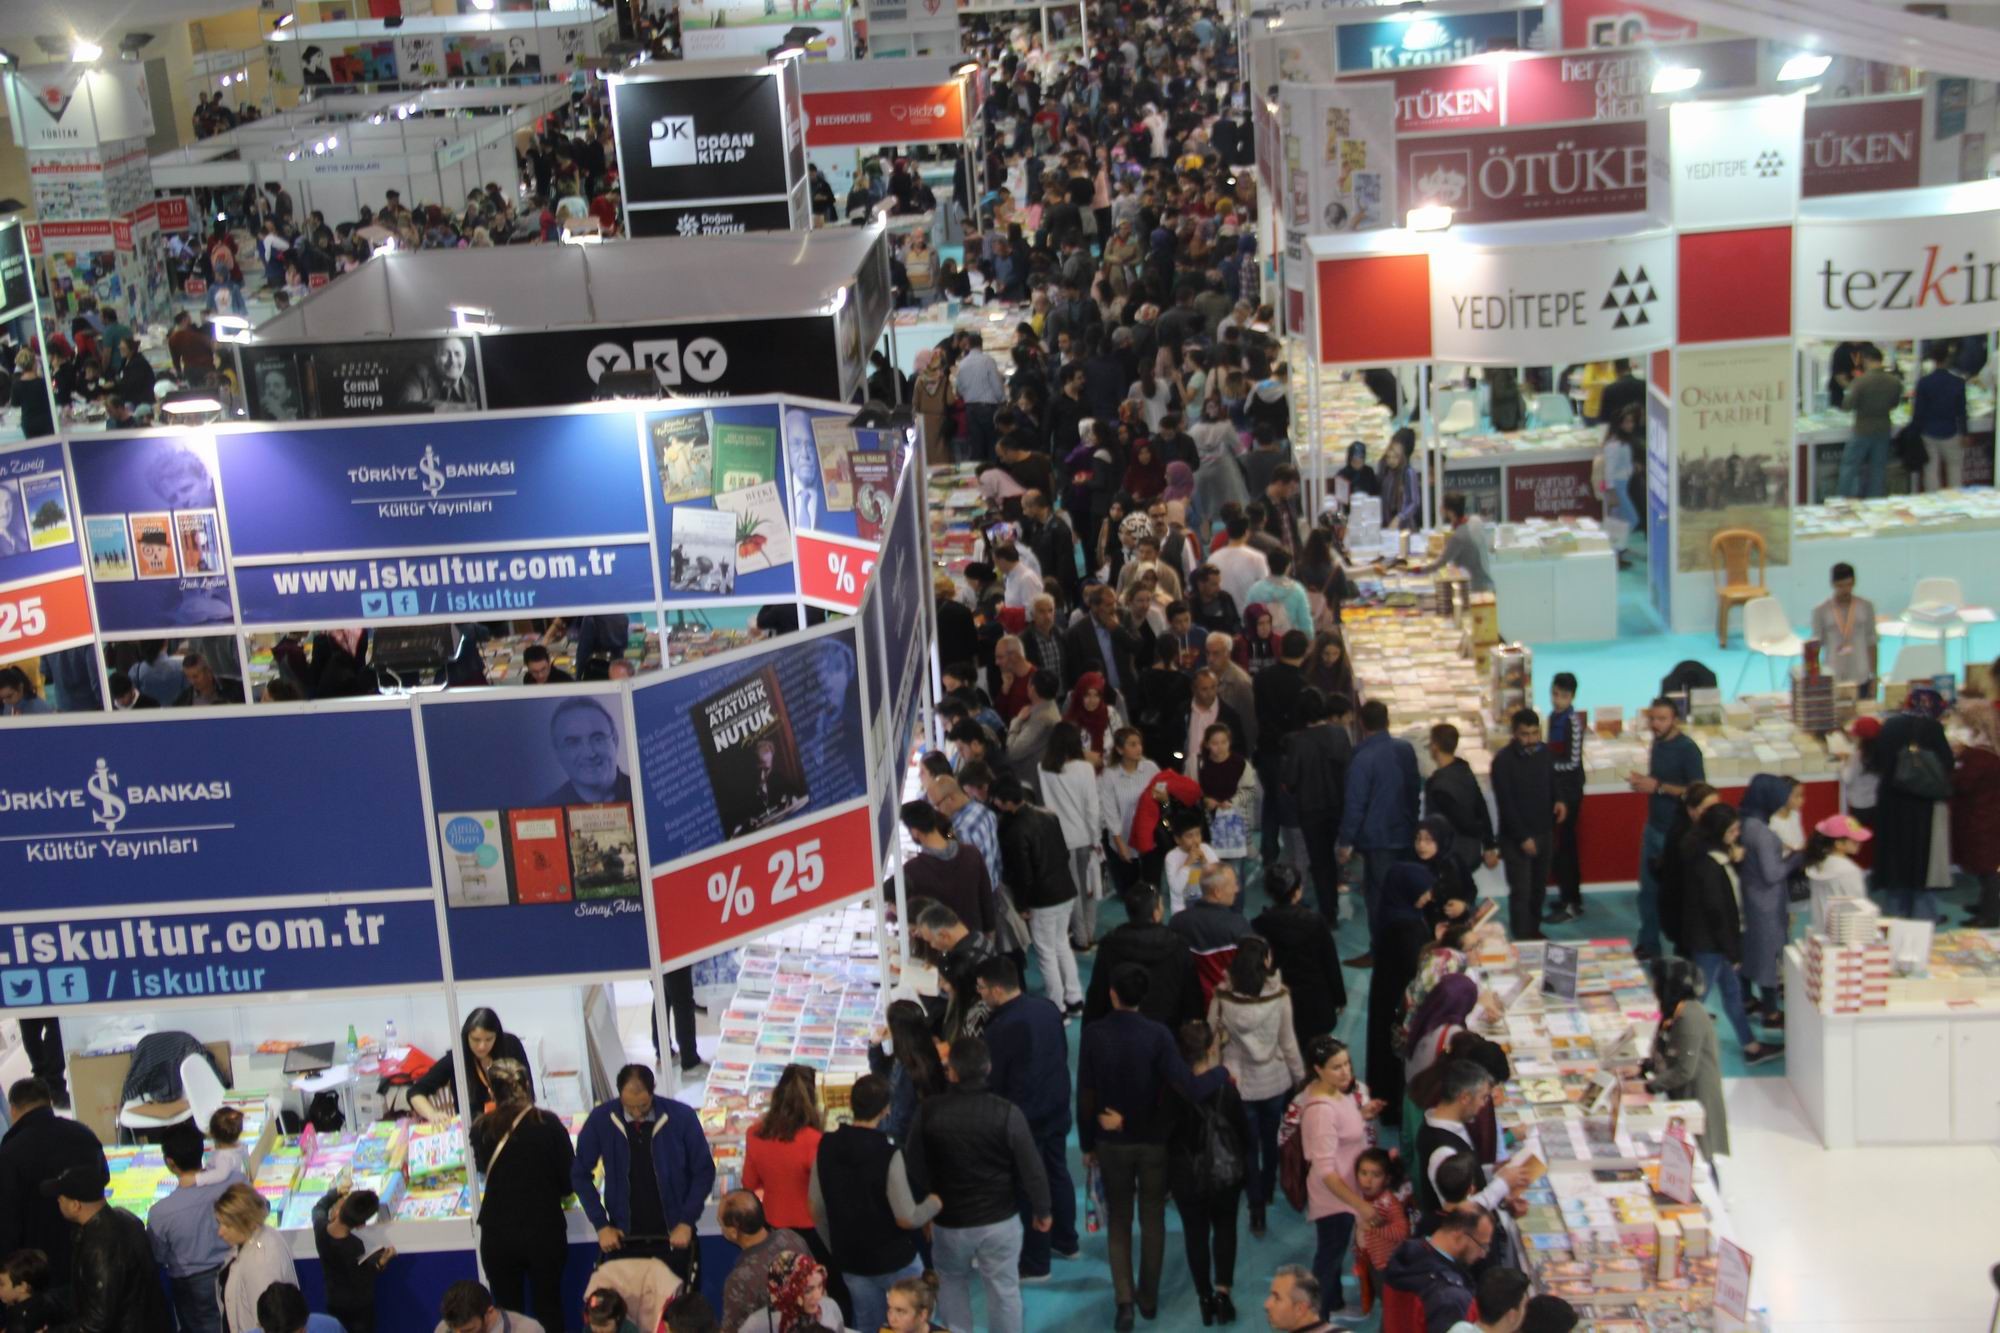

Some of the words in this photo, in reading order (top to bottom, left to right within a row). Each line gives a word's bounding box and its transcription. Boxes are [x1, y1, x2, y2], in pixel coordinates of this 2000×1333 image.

[1561, 58, 1594, 82] her
[815, 112, 873, 126] REDHOUSE
[651, 120, 689, 141] DK
[697, 133, 754, 150] DOĞAN
[698, 148, 746, 164] KİTAP
[1685, 158, 1748, 180] YEDİTEPE
[701, 213, 734, 225] Doğan
[1451, 287, 1588, 331] YEDİTEPE
[343, 375, 380, 394] Cemal
[343, 394, 384, 411] Süreya
[10, 458, 45, 473] Zweig
[347, 465, 418, 484] TÜRKİYE
[445, 461, 516, 478] BANKASI
[378, 501, 426, 518] Kültür
[428, 499, 492, 517] Yayınları
[273, 548, 617, 595] www.iskultur.com.tr
[178, 579, 199, 592] Jack
[201, 576, 228, 590] London
[446, 588, 536, 613] iskultur
[713, 704, 775, 753] NUTUK
[127, 781, 231, 805] BANKASI
[26, 841, 97, 864] Kültür
[100, 836, 199, 861] Yayınları
[767, 838, 825, 906] 25
[574, 902, 612, 918] Sunay
[0, 908, 385, 966] .iskultur.com.tr
[132, 964, 267, 998] iskultur
